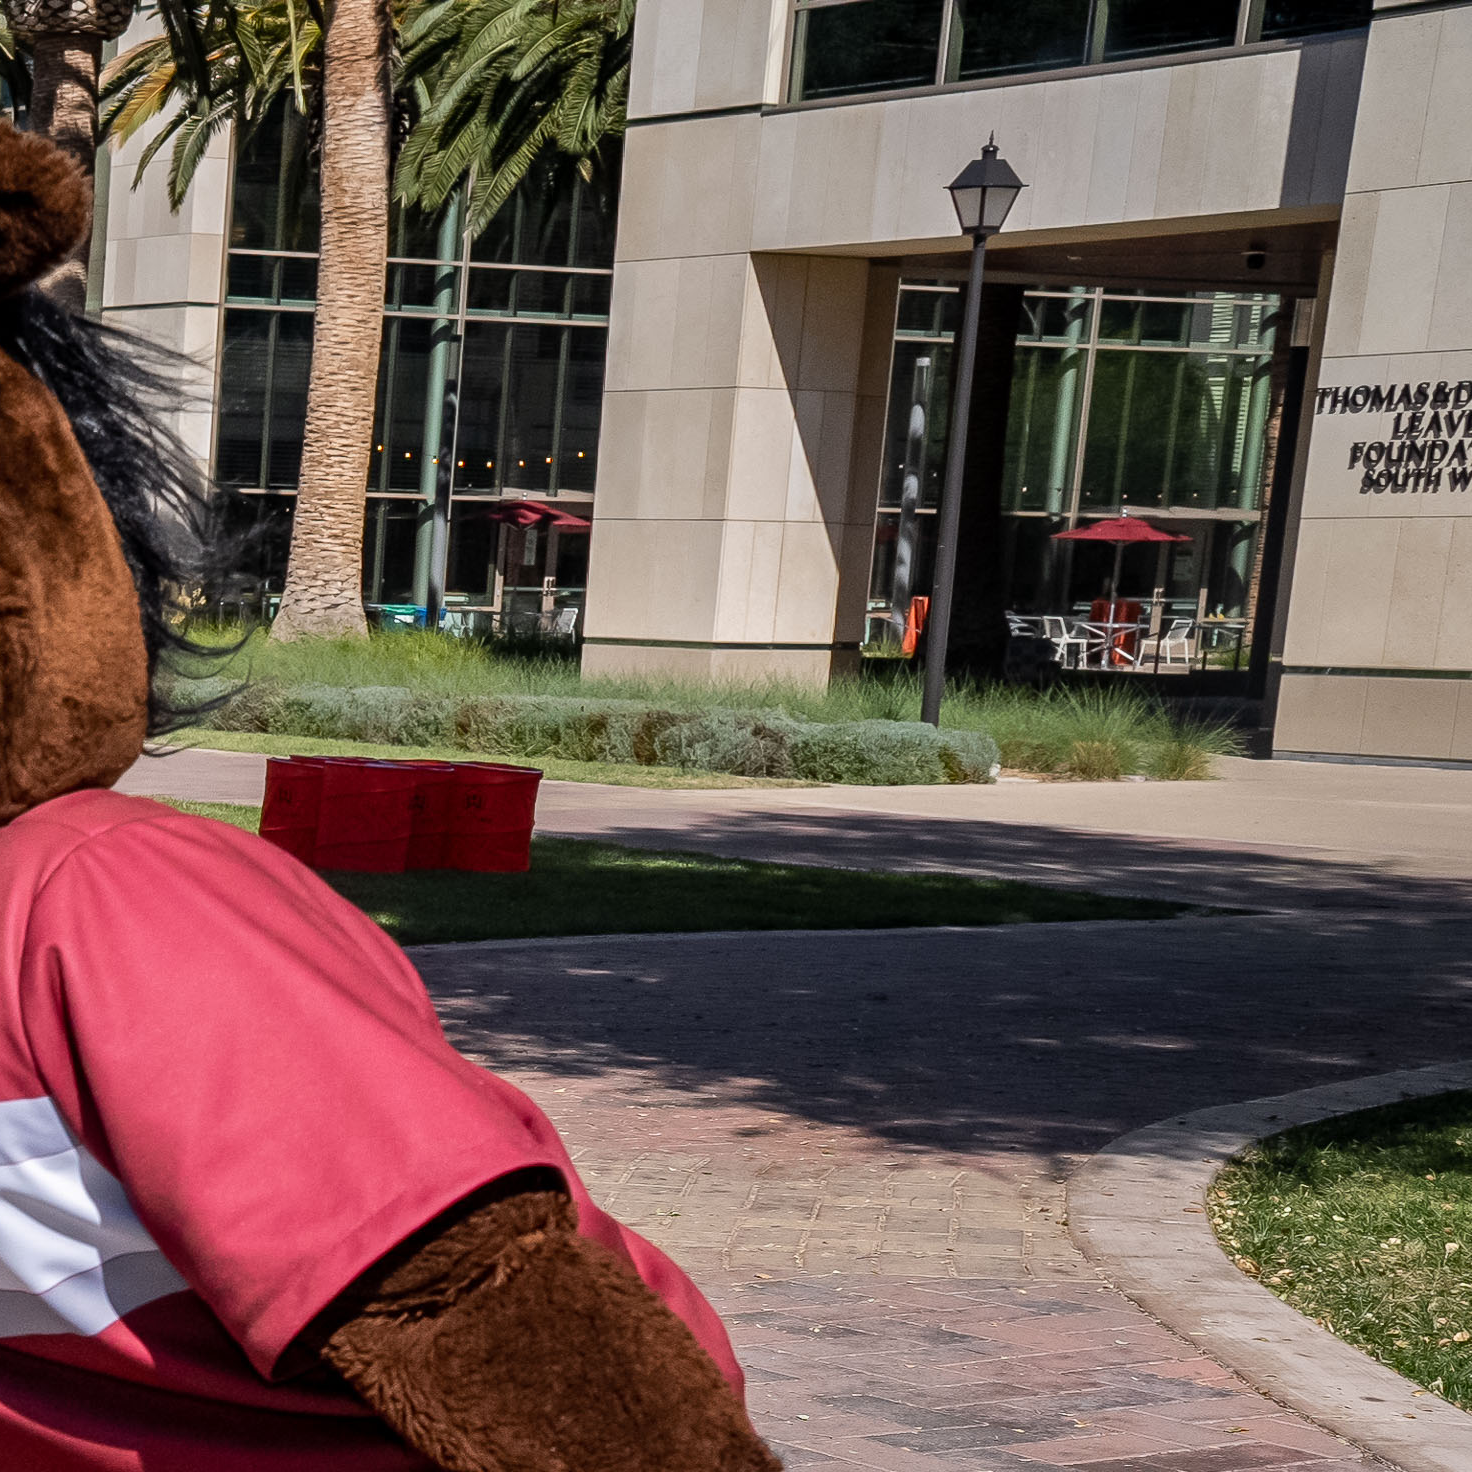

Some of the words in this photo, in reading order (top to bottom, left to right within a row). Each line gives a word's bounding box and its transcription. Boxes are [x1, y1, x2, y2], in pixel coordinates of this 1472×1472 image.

[1316, 382, 1430, 415] THOMAS
[1348, 439, 1472, 470] FOUNDA
[1359, 467, 1443, 494] SOUTH
